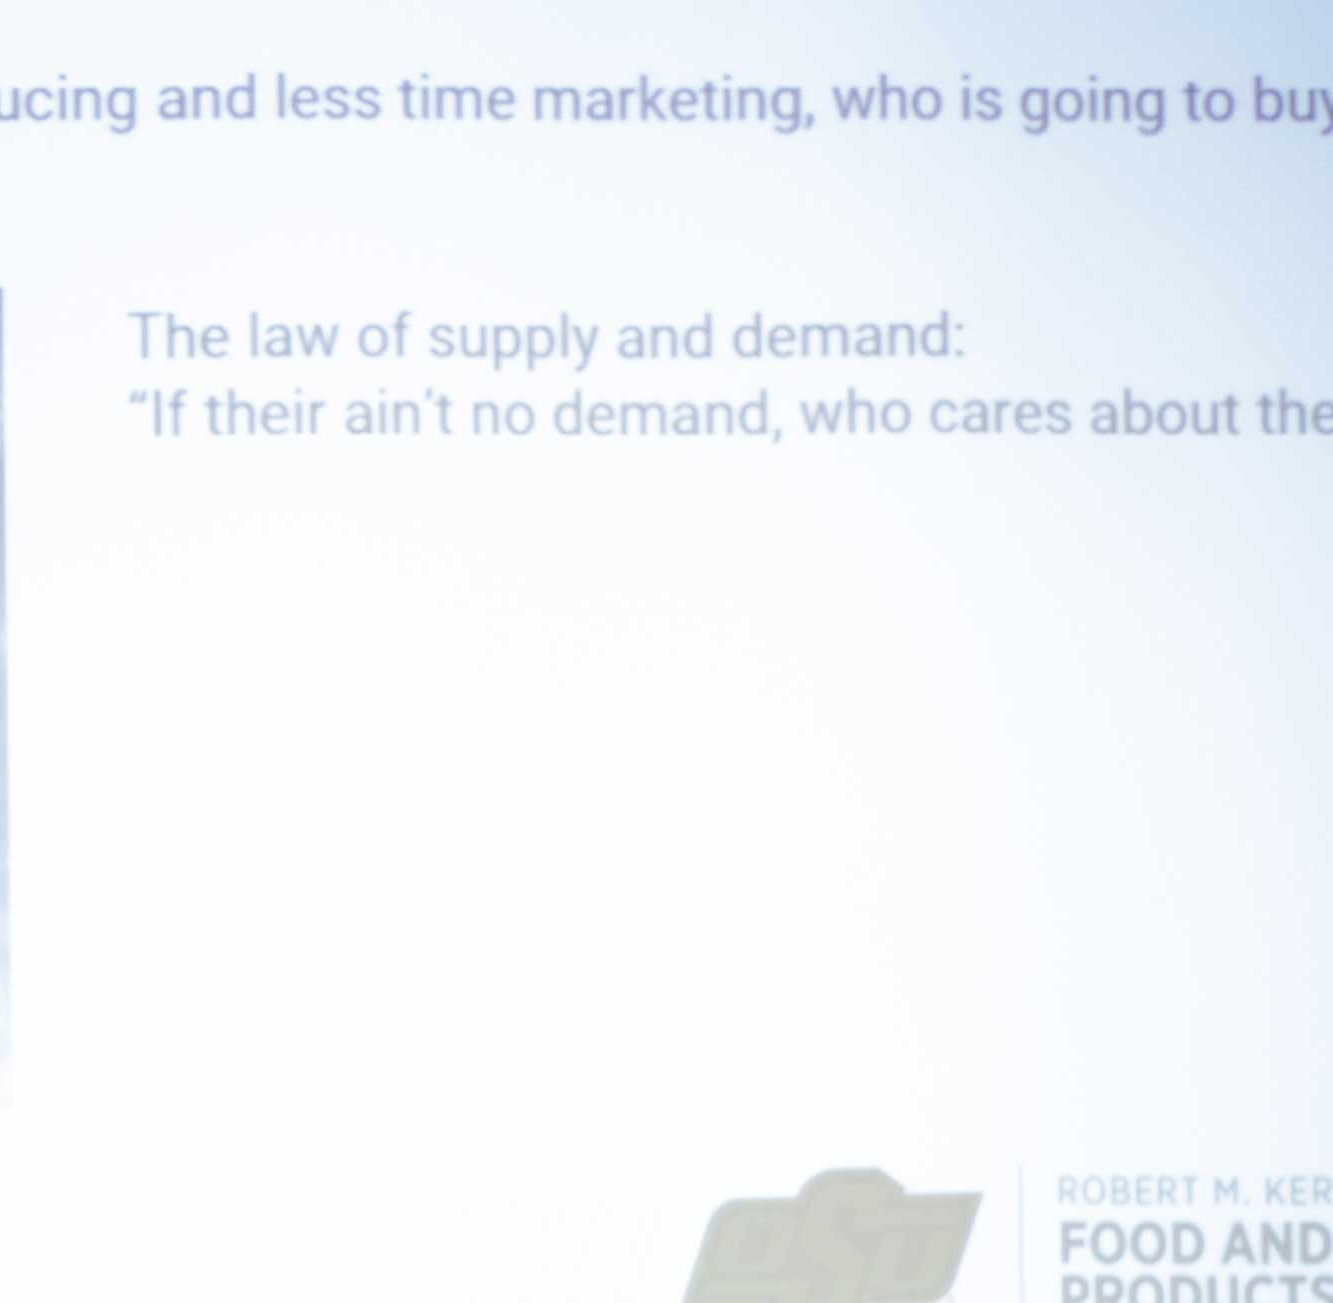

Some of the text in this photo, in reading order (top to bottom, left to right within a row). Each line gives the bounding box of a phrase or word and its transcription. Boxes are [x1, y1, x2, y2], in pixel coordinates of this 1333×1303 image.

[157, 72, 257, 121] and
[277, 72, 382, 120] less
[397, 72, 517, 121] time
[533, 73, 815, 133] marketing,
[832, 74, 944, 121] who
[962, 73, 1004, 122] is
[1019, 74, 1166, 136] going
[1182, 81, 1236, 123] to
[128, 309, 964, 372] The law of supply and demand:
[204, 388, 325, 436] their
[473, 401, 536, 436] no
[553, 388, 783, 444] demand,
[799, 386, 912, 434] who
[929, 398, 1072, 435] cares
[1090, 387, 1240, 436] about
[1057, 1174, 1199, 1208] ROBERT
[1213, 1174, 1251, 1208] M.
[1060, 1219, 1333, 1266] FOOD AND
